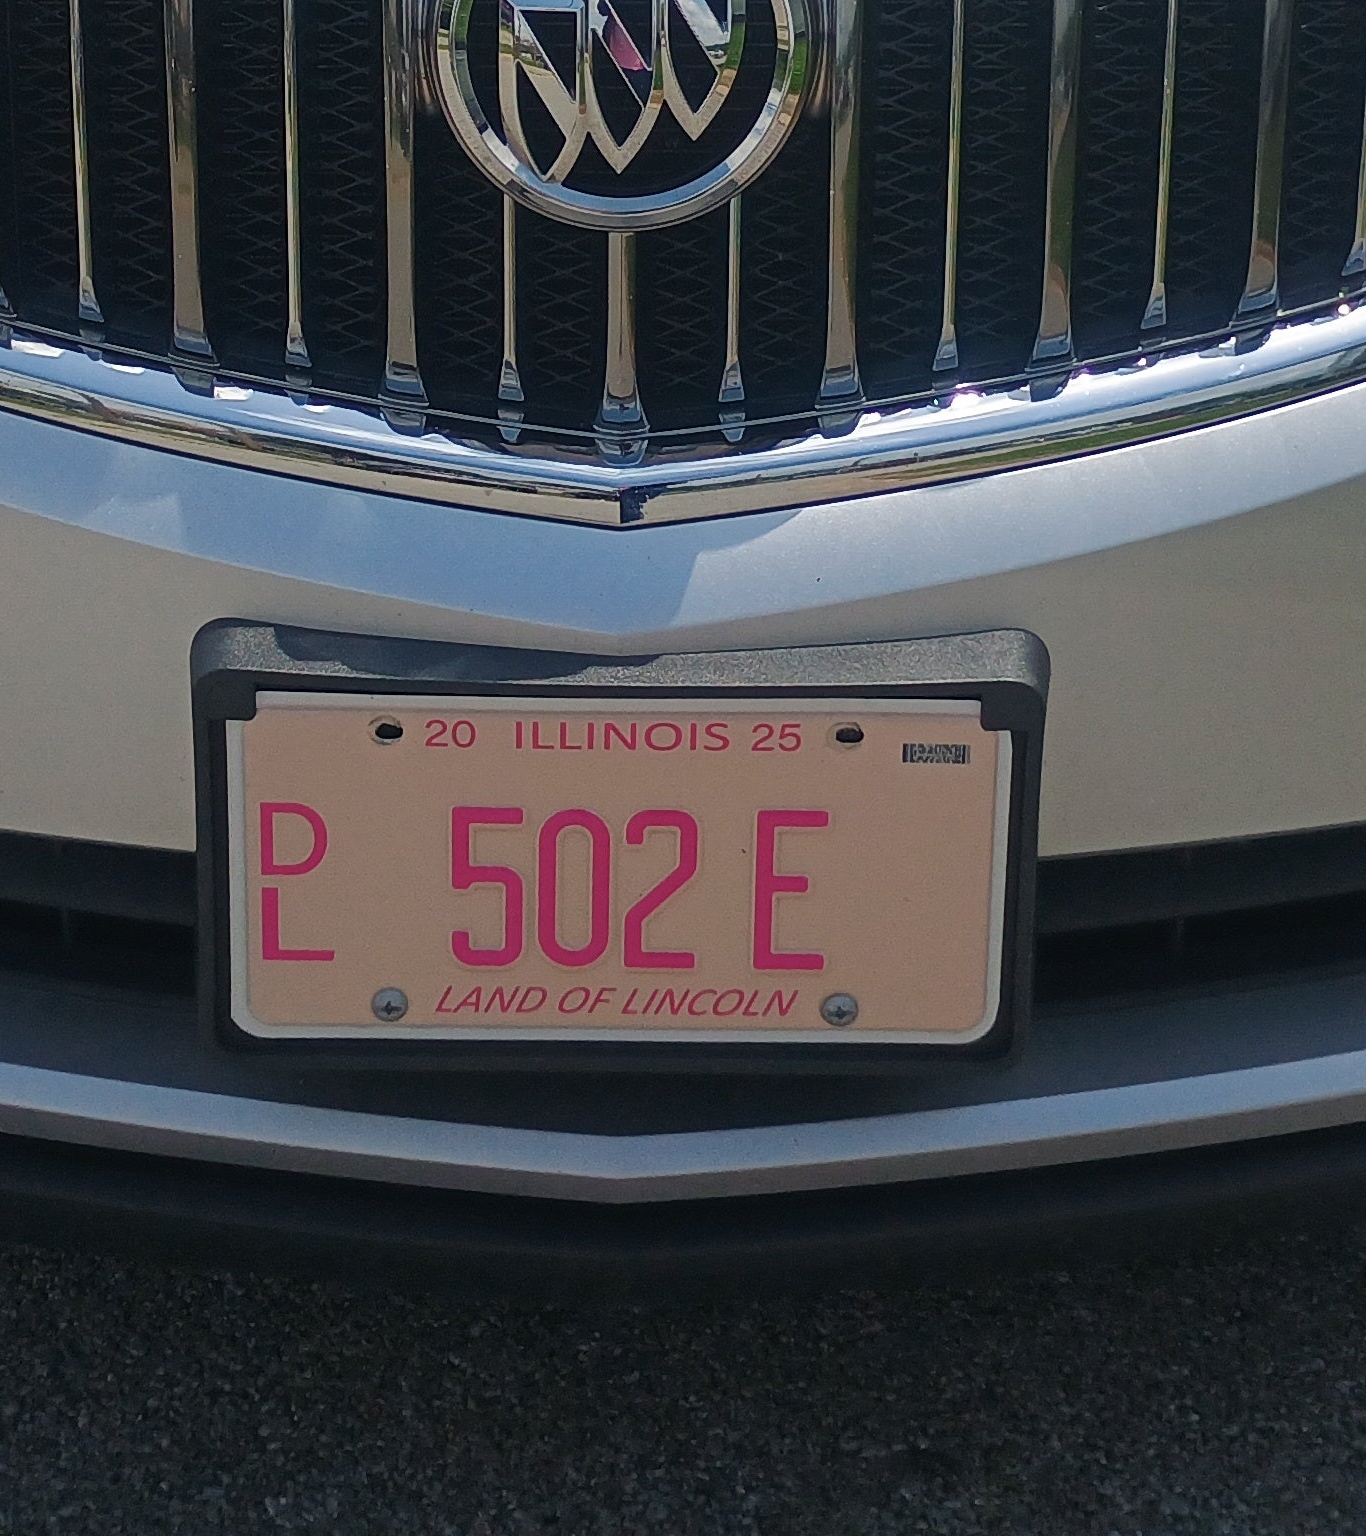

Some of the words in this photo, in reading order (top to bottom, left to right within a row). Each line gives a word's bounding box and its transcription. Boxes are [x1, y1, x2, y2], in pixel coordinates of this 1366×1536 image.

[425, 718, 478, 750] 20
[514, 720, 732, 753] ILLINOIS
[751, 721, 803, 753] 25
[435, 985, 549, 1015] LAND
[556, 985, 619, 1016] OF
[621, 988, 799, 1018] LINCOLN
